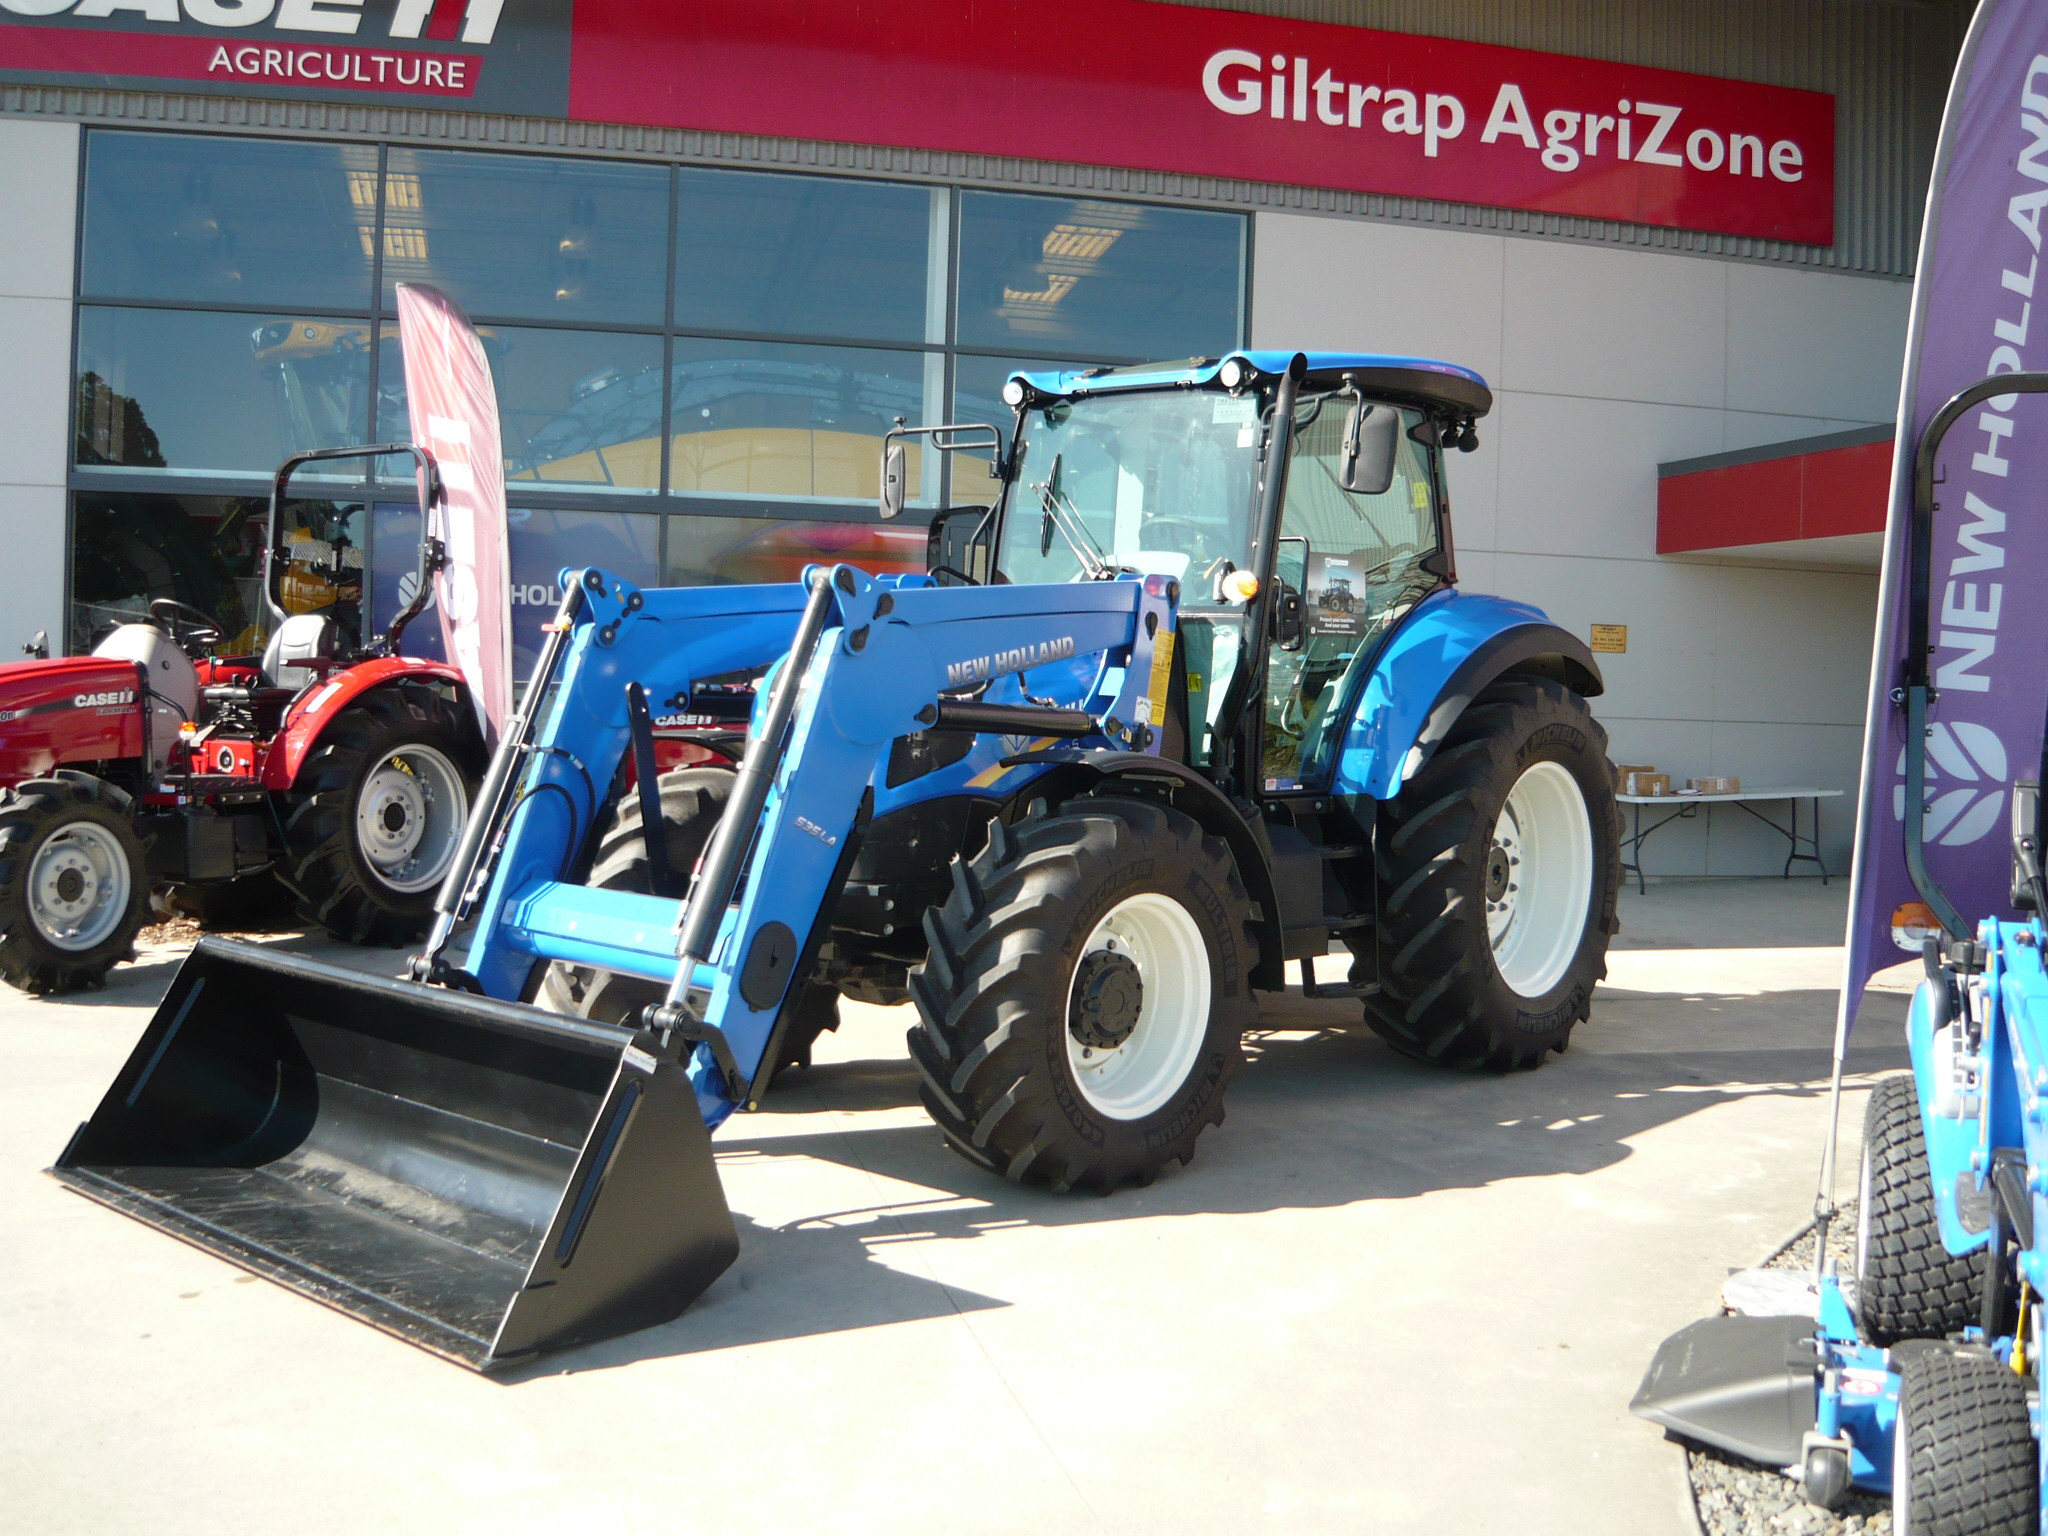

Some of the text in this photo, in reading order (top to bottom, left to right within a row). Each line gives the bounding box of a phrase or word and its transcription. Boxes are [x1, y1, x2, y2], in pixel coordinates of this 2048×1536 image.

[208, 46, 466, 89] AGRICULTURE
[1202, 49, 1804, 183] Giltrap AgriZone
[1936, 53, 2048, 693] NEW HOLLAND
[947, 635, 1074, 687] NEW HOLLAND
[96, 705, 136, 716] FARMALL
